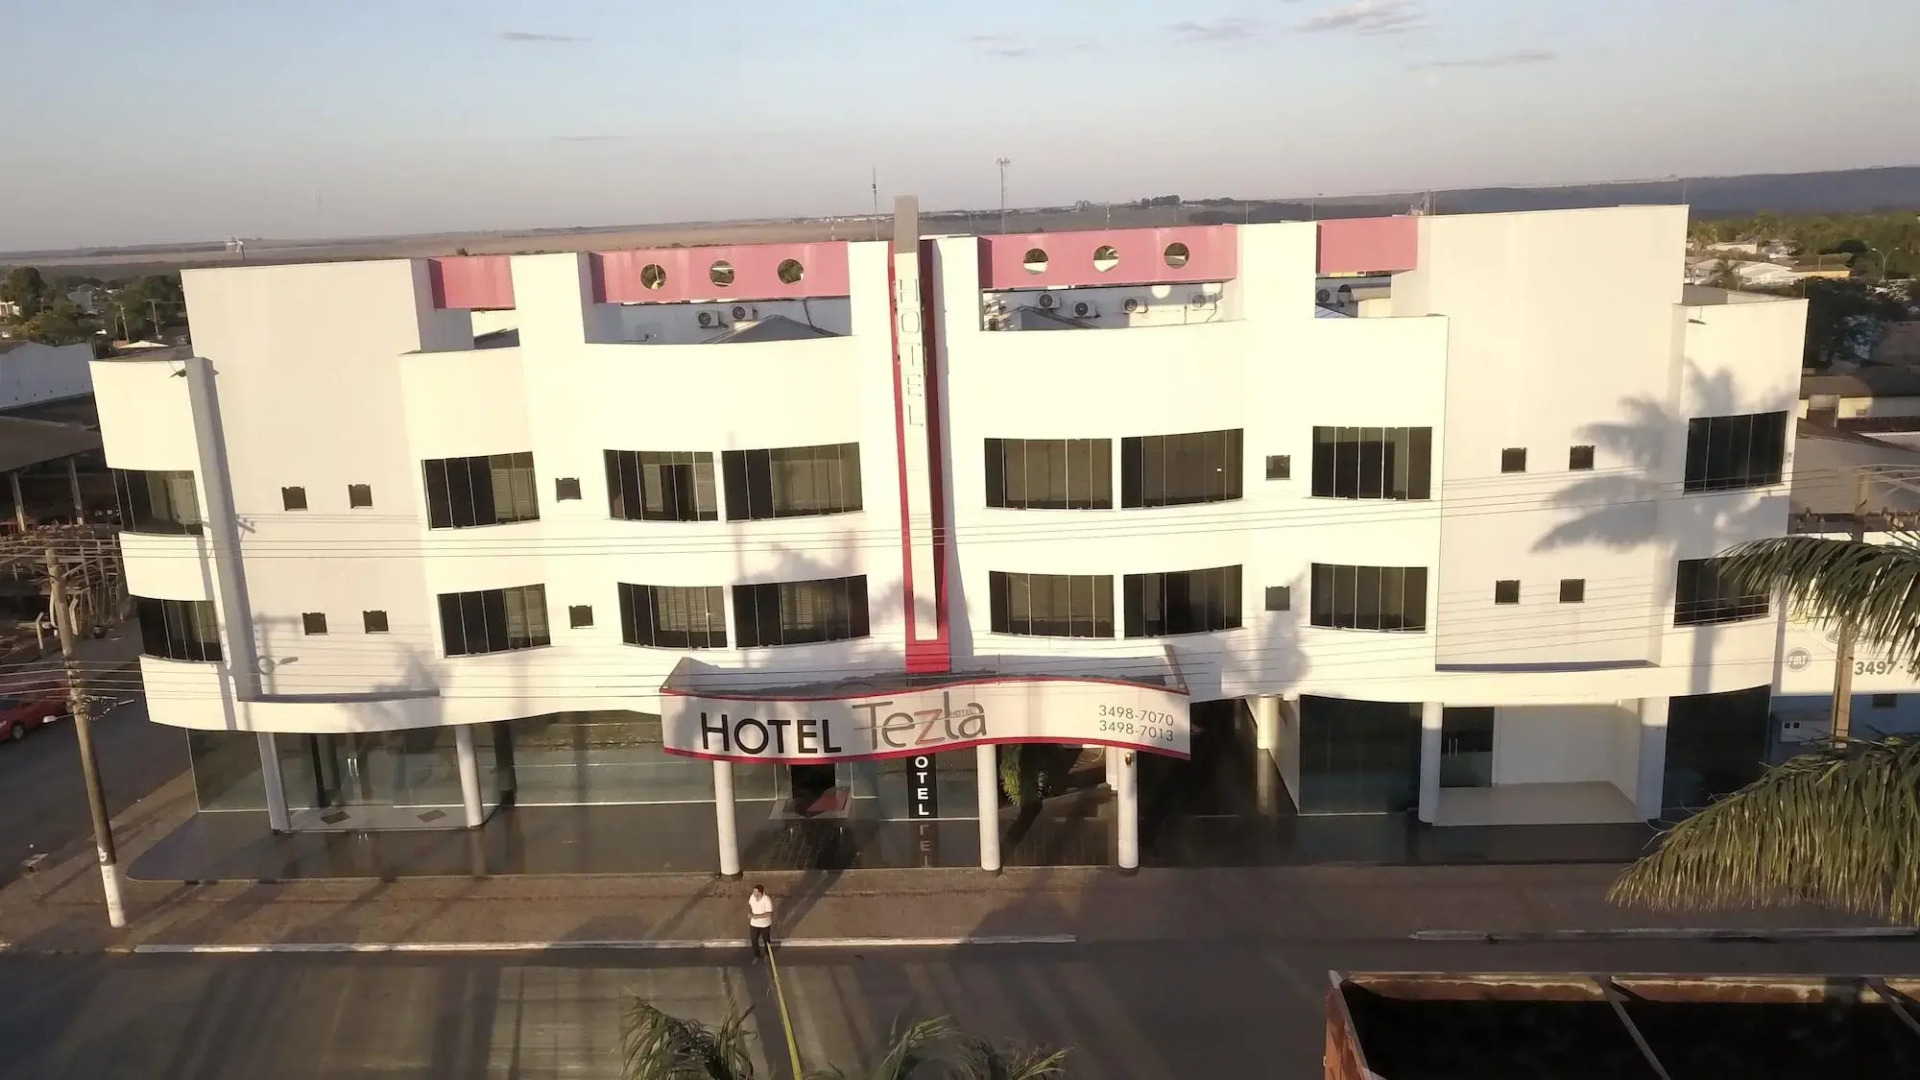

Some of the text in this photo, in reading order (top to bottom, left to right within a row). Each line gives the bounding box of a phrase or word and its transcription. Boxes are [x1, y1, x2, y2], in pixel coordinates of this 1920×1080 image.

[700, 691, 987, 755] HOTEL Tezla
[1098, 704, 1174, 727] 3498-7070
[1099, 719, 1174, 742] 3498-7013
[914, 756, 930, 816] OTEL
